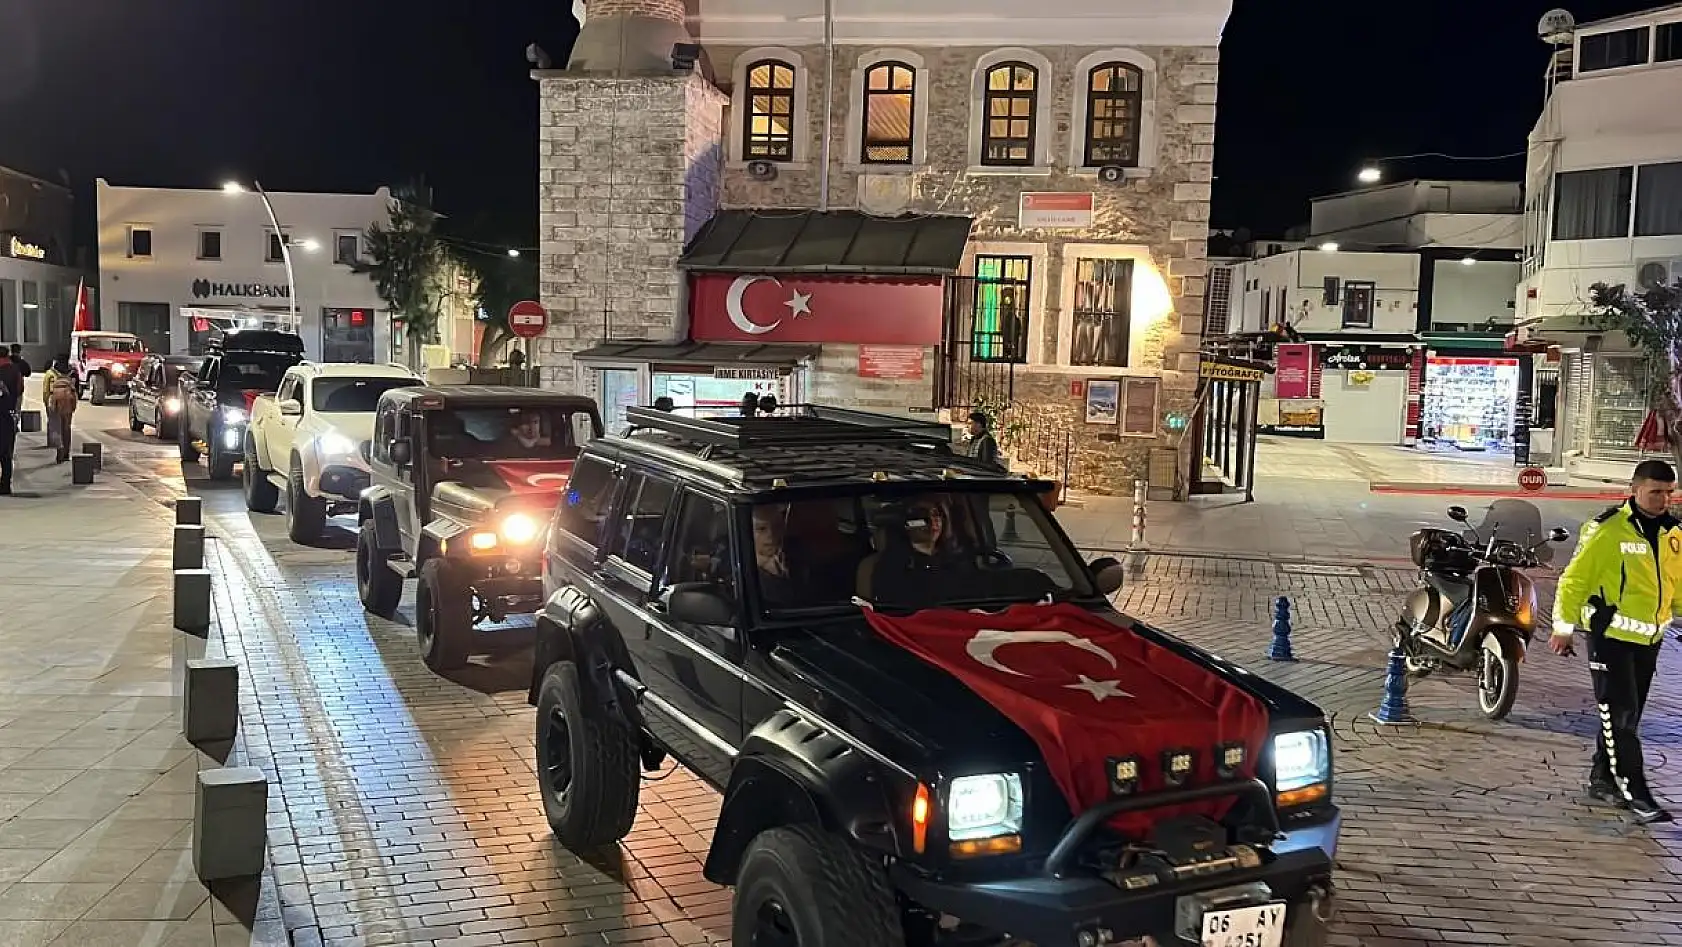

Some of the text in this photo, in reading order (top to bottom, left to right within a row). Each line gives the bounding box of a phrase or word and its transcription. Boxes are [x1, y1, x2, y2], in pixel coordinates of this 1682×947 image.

[1522, 475, 1543, 484] DUR
[1209, 908, 1281, 933] 06 AY
